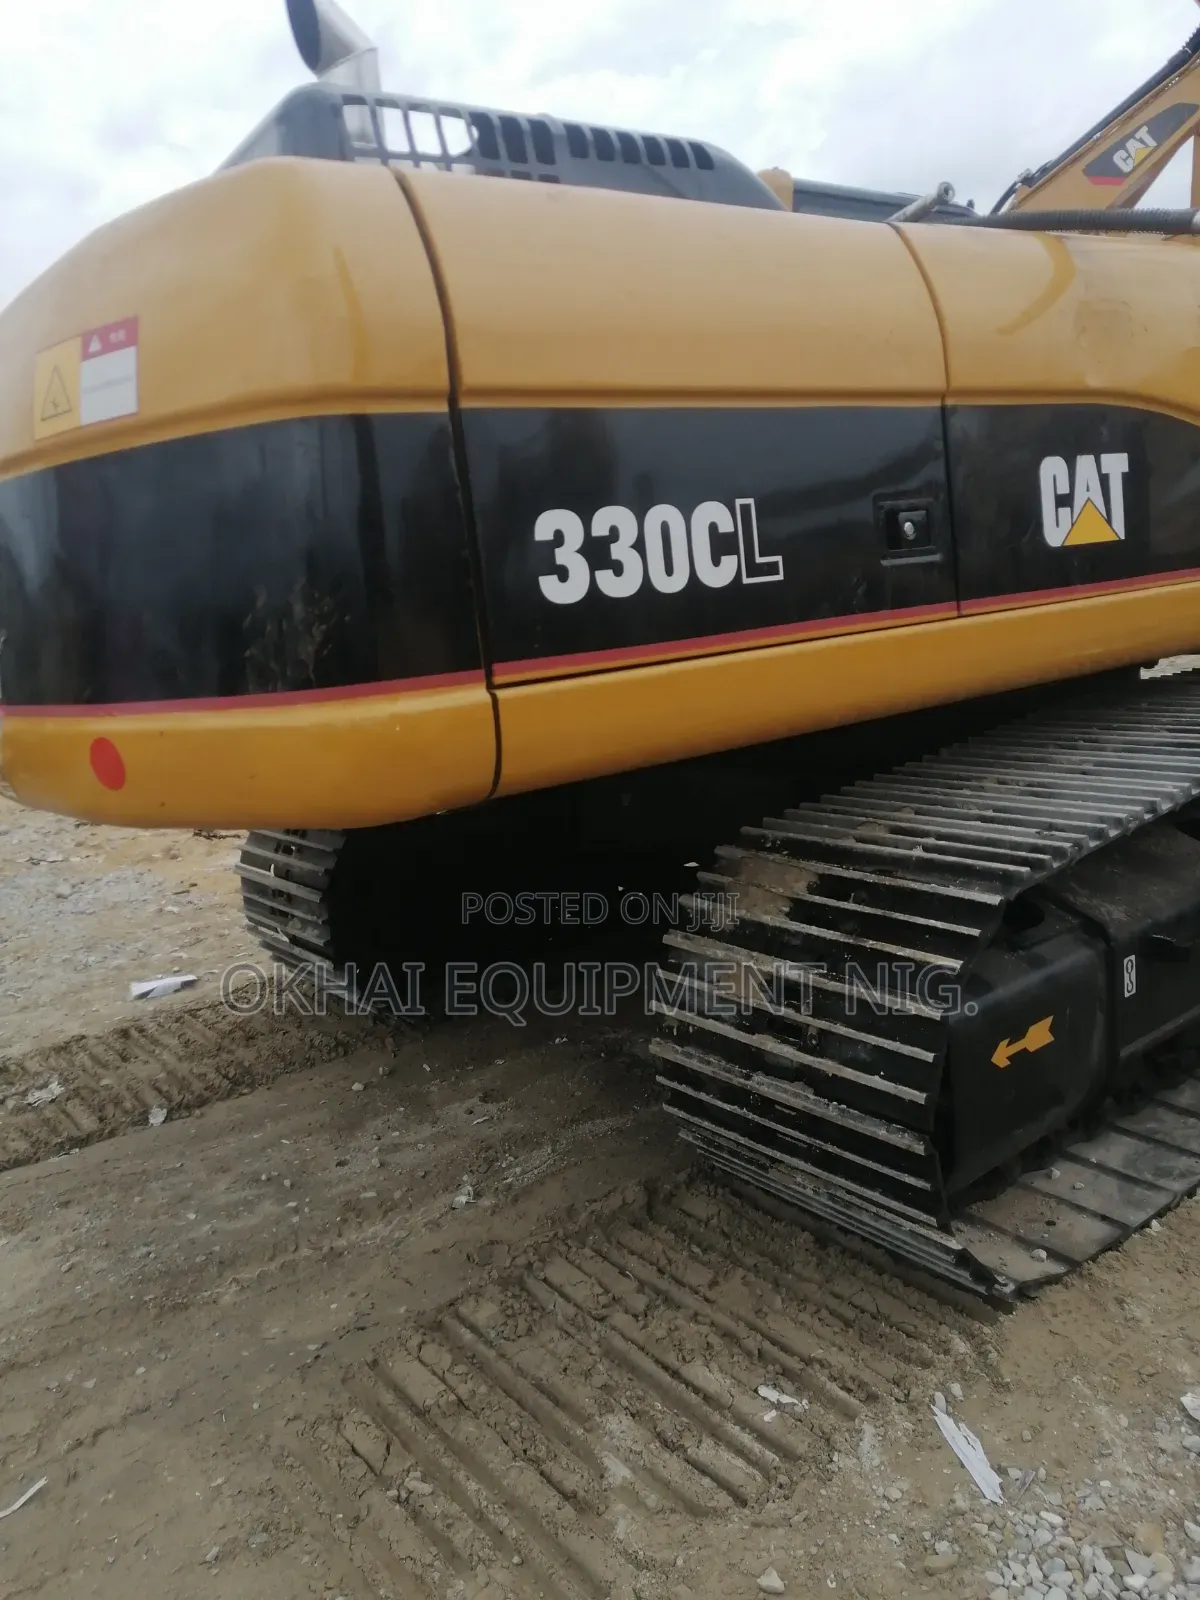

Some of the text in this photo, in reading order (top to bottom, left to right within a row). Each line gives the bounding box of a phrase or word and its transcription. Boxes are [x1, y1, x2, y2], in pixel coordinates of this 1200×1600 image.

[1112, 125, 1158, 173] CAT
[1039, 452, 1129, 547] CAT
[534, 498, 784, 604] 330CL
